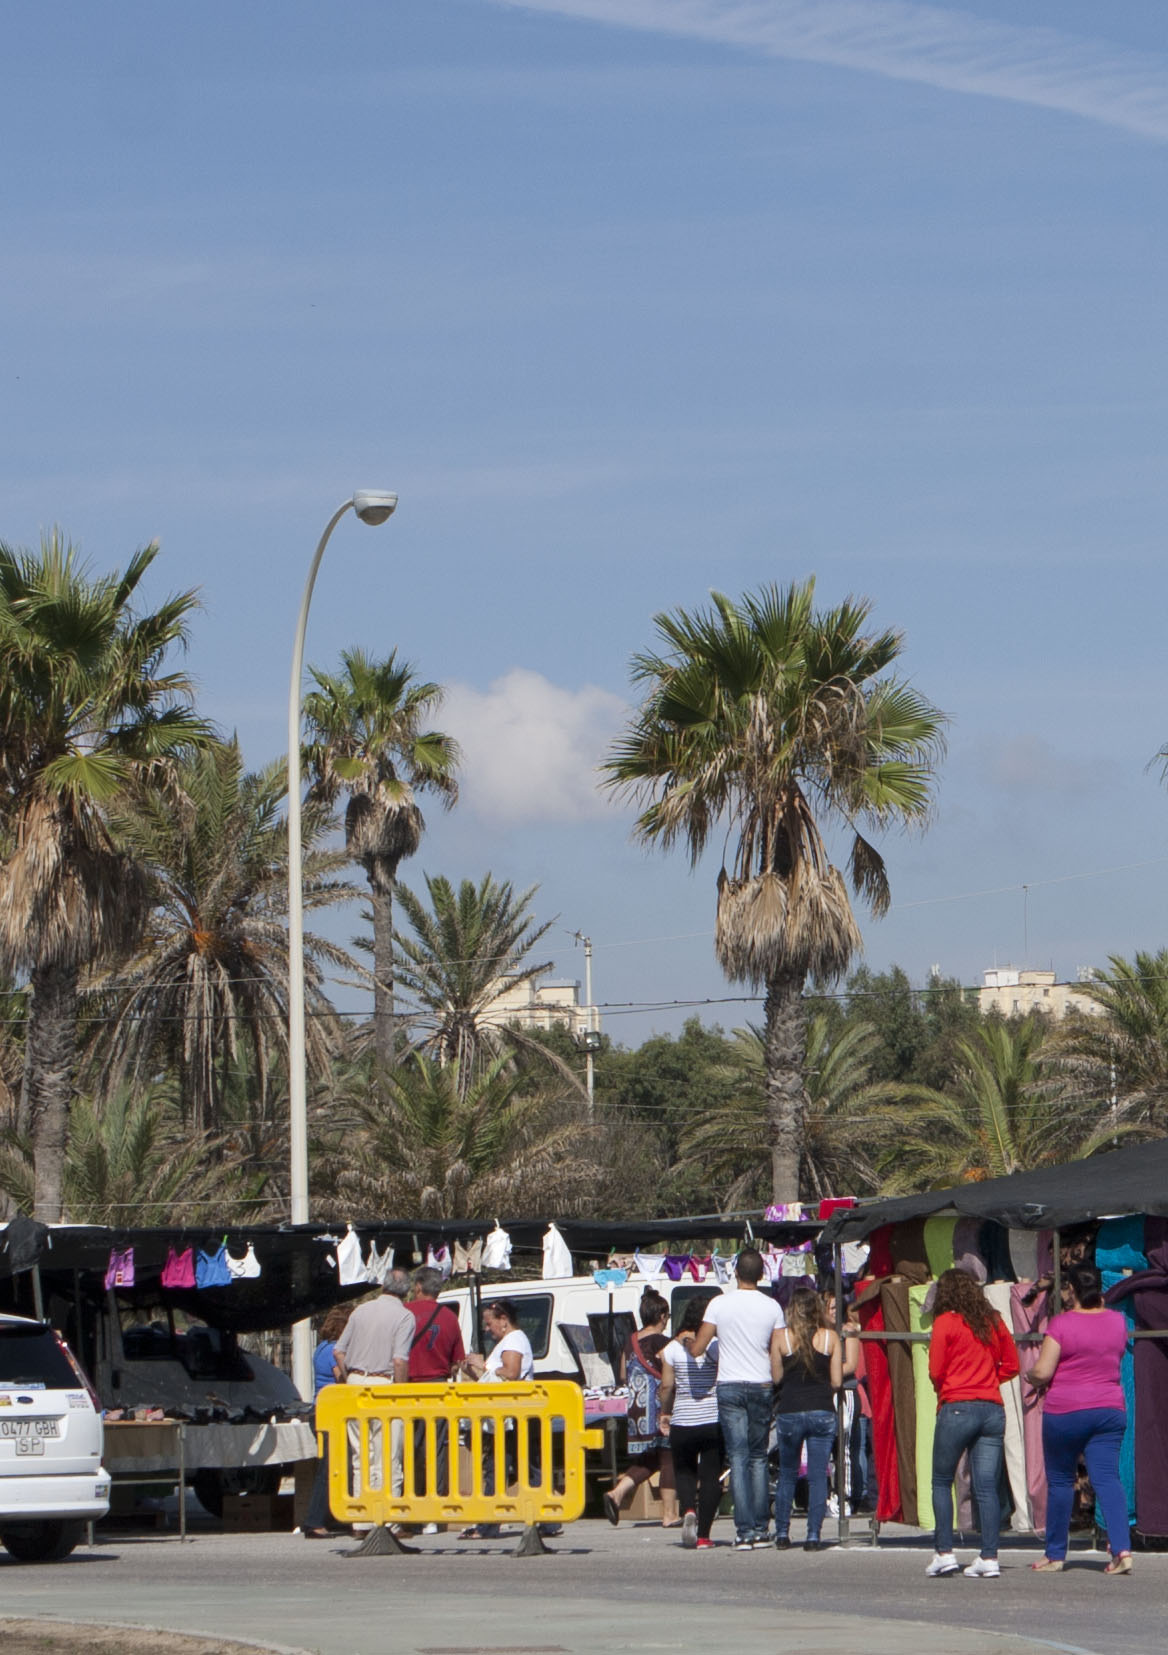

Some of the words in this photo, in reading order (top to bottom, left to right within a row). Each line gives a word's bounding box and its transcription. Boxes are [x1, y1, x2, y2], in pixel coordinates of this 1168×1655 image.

[1, 1421, 31, 1436] 0477
[35, 1420, 58, 1435] GBH
[20, 1438, 40, 1453] SP
